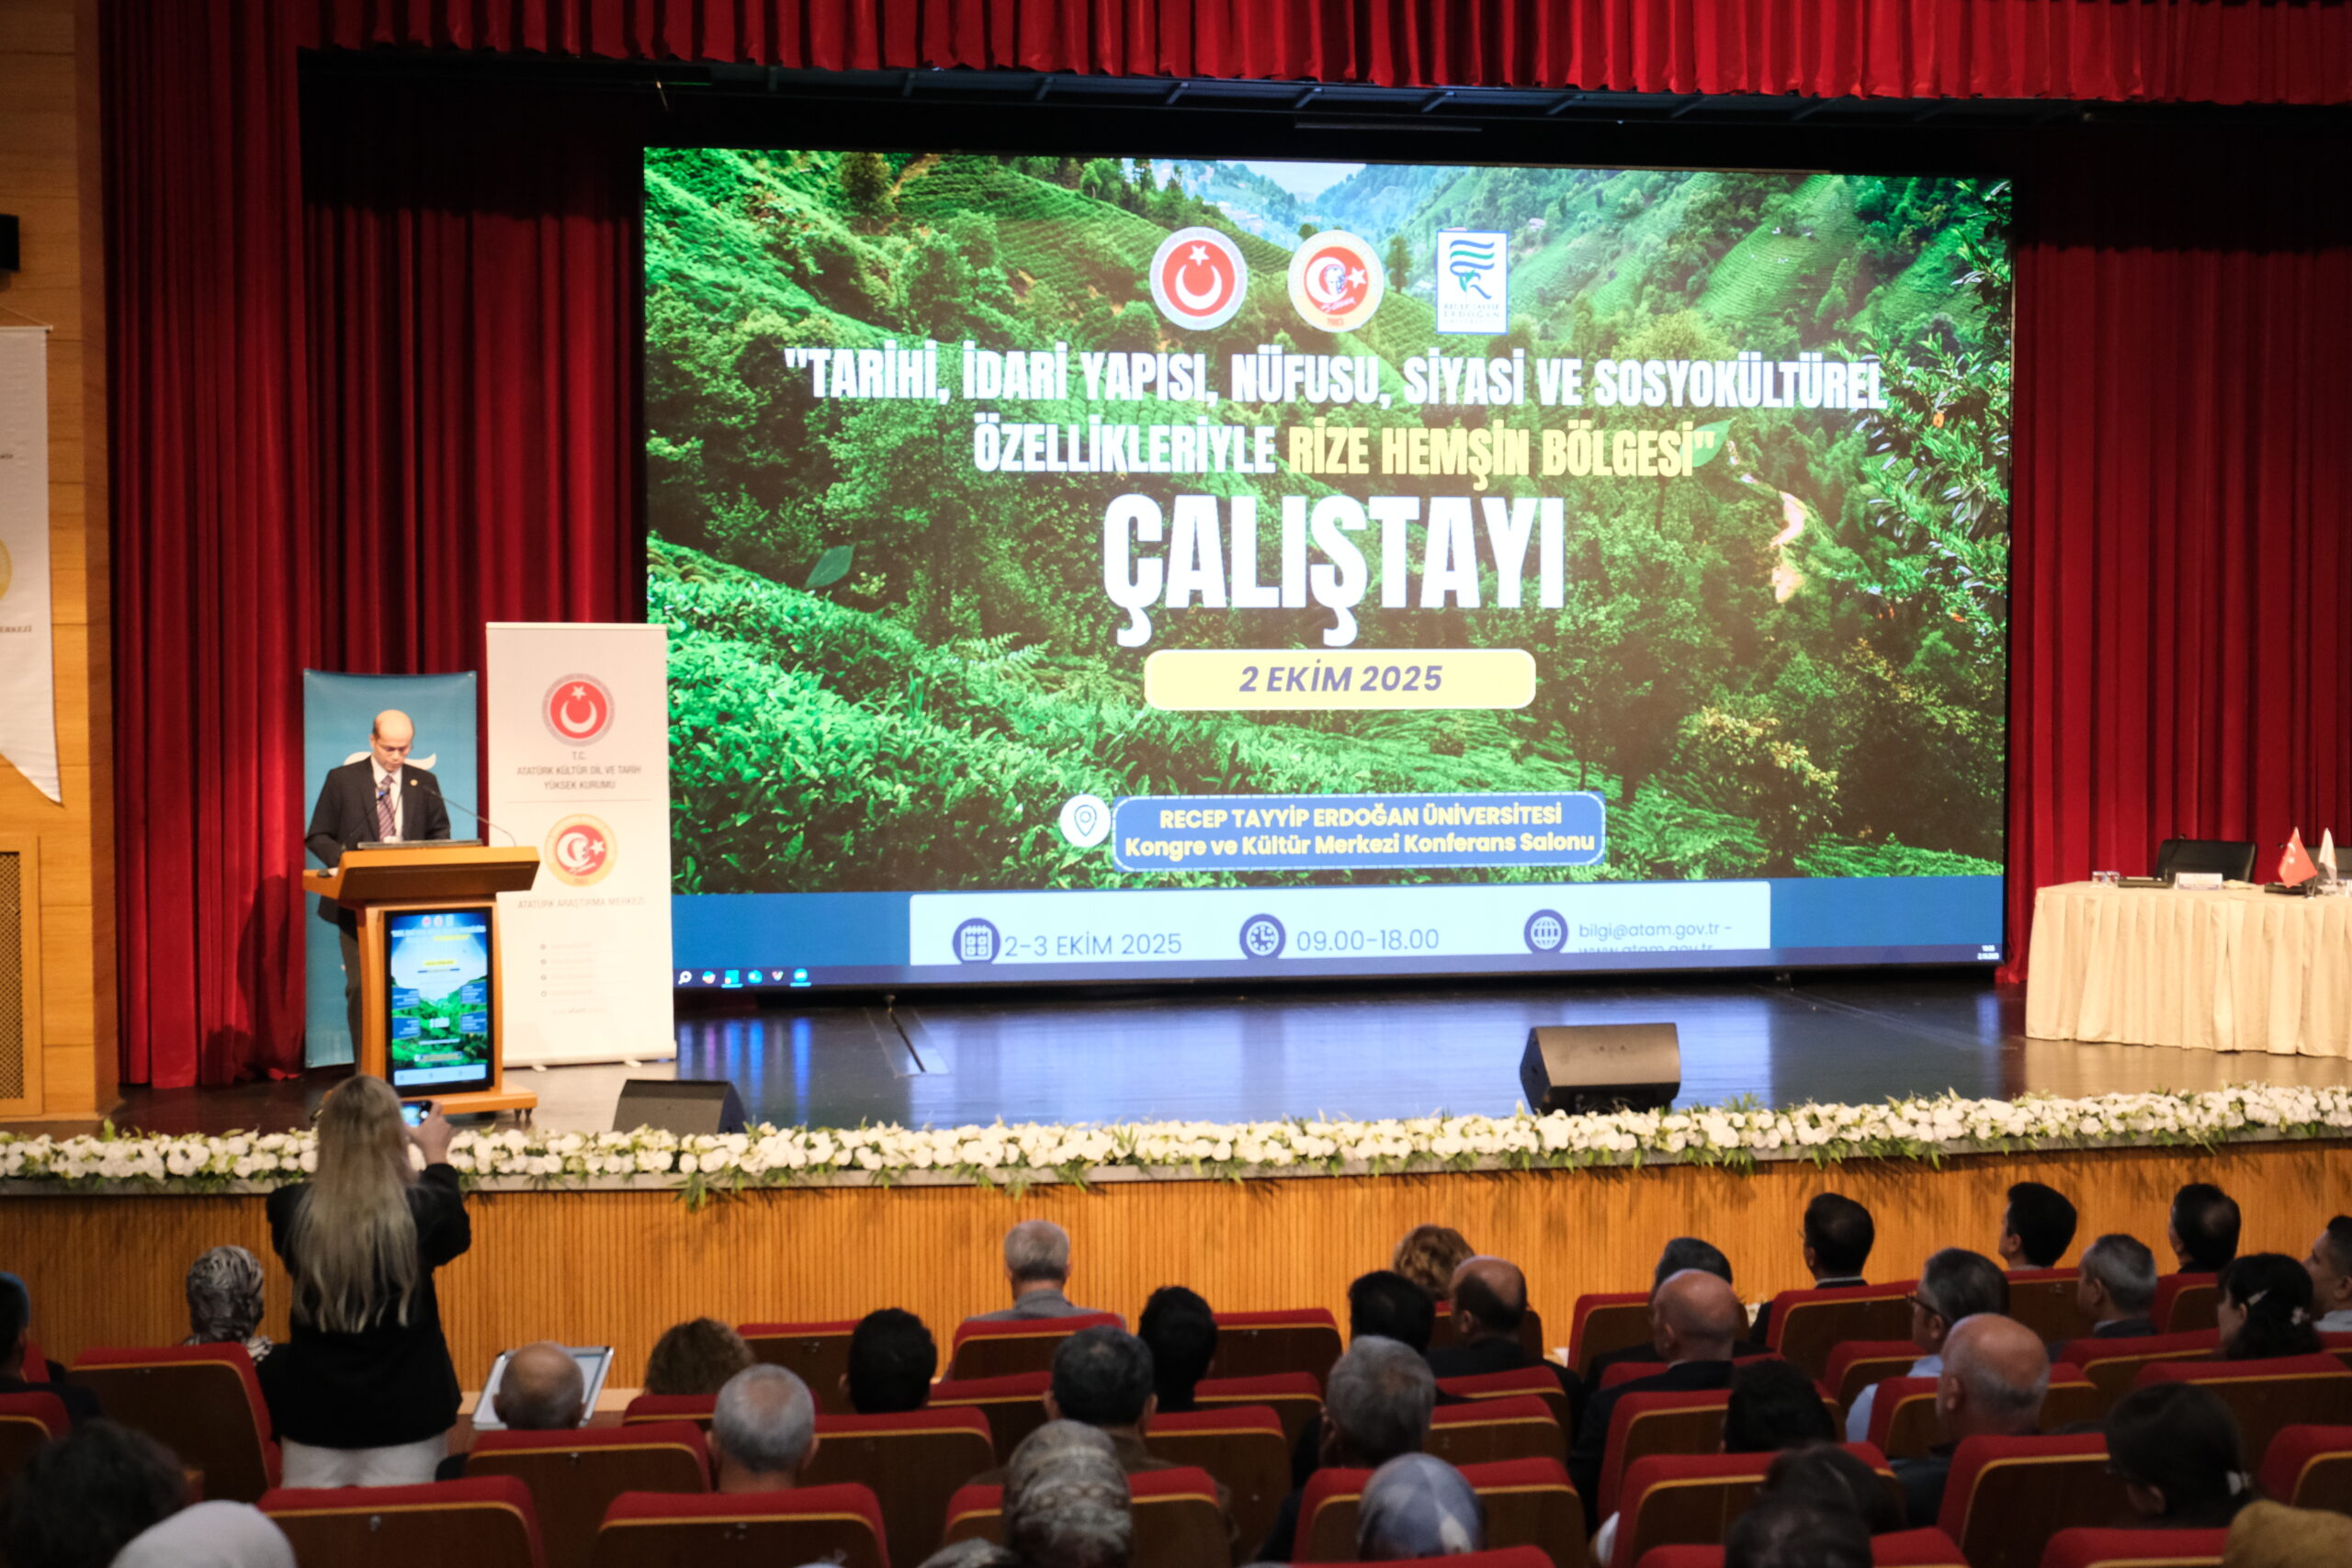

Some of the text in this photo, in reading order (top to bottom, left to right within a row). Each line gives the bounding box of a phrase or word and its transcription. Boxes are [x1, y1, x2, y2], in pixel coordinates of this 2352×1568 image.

[784, 339, 1888, 410] "TARİHİ, İDARİ YAPISI, NÜFUSU, SİYASİ VE SOSYOKÜLTÜREL
[973, 412, 1716, 491] ÖZELLİKLERİYLE RİZE HEMŞİN BÖLGESİ"
[1103, 493, 1565, 648] ÇALIŞTAYI
[1238, 659, 1443, 693] 2 EKİM 2025
[605, 765, 616, 775] VE
[1159, 801, 1563, 829] RECEP TAYYİP ERDOĞAN ÜNİVERSİTESİ
[1125, 831, 1595, 862] Kongre ve Kültür Merkezi Konferans Salonu
[1057, 931, 1113, 956] EKİM
[1121, 932, 1182, 955] 2025
[1578, 922, 1720, 942] bilgi@atam.gov.tr
